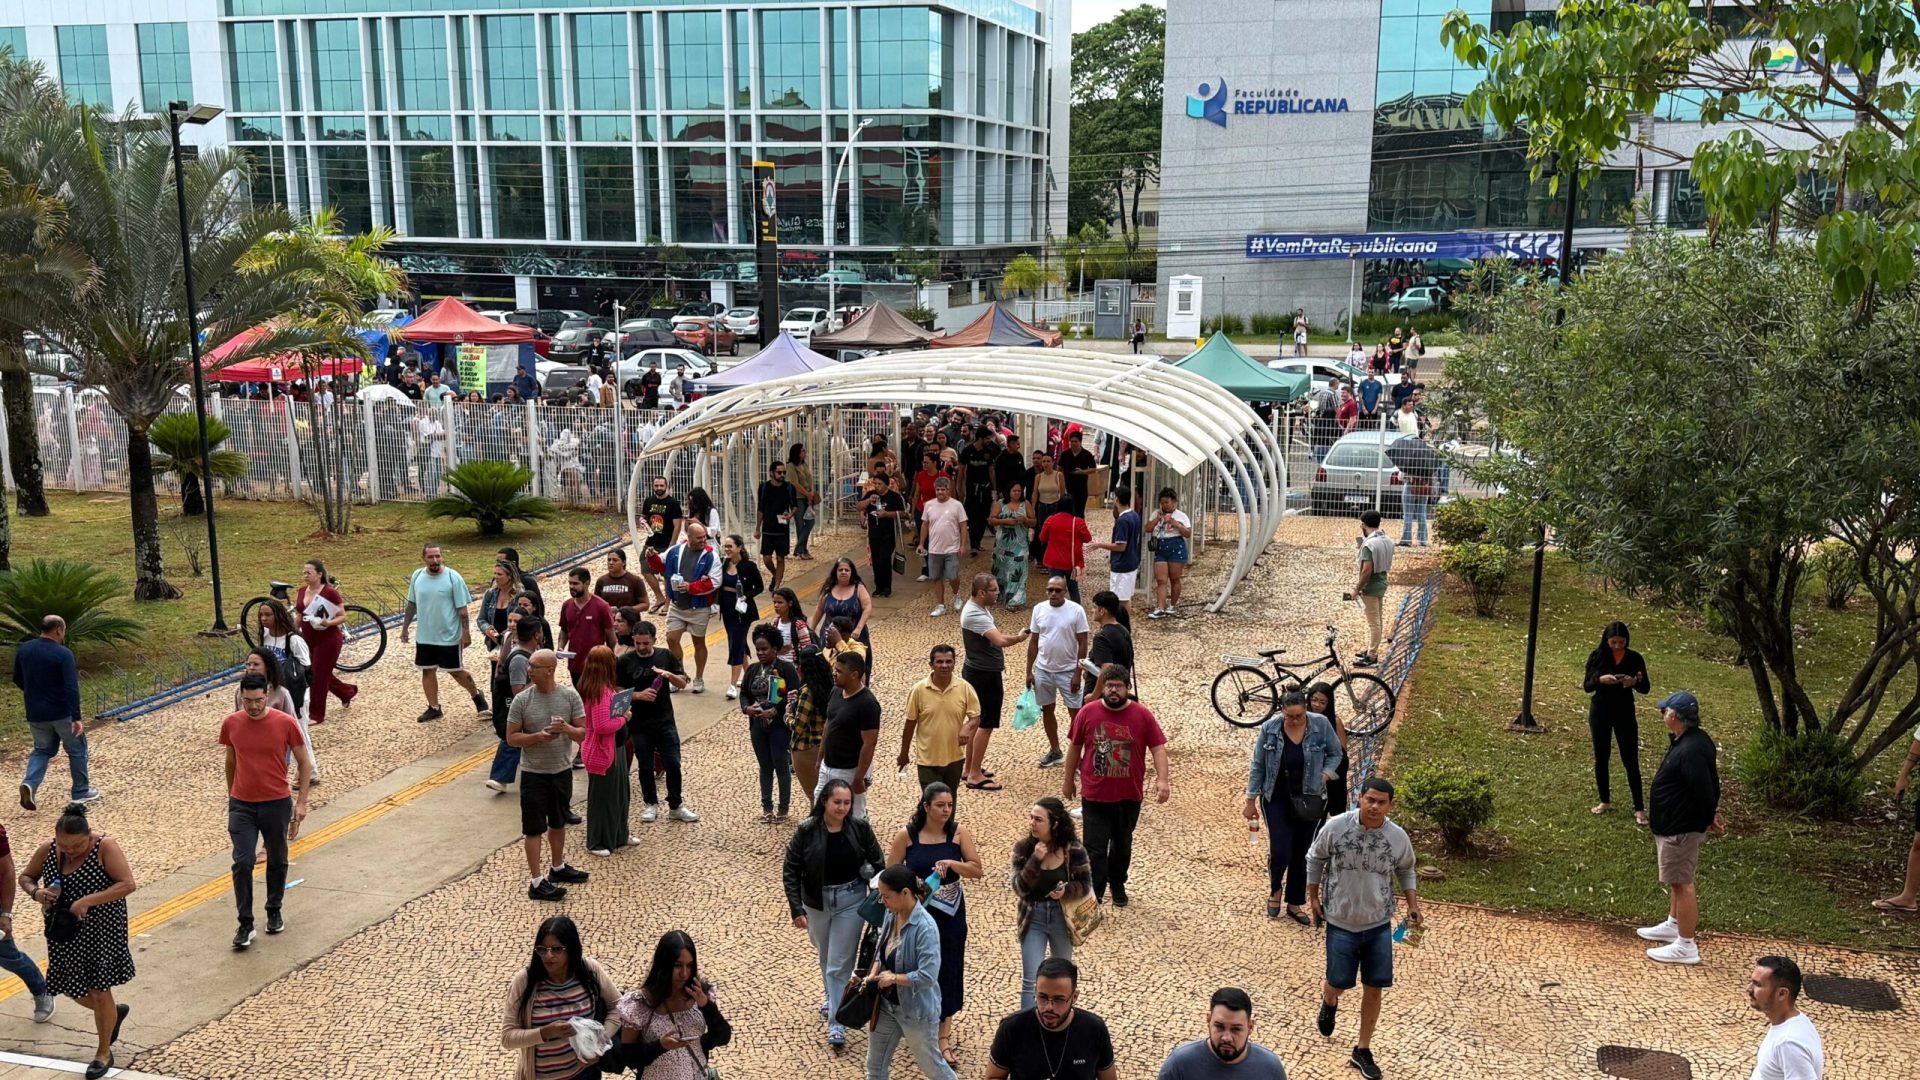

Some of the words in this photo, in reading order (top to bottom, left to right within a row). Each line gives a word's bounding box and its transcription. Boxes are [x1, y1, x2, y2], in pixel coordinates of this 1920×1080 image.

[1235, 88, 1299, 97] Faculdade
[1234, 98, 1350, 114] REPUBLICANA
[1250, 236, 1438, 256] #VemPraRepublicana
